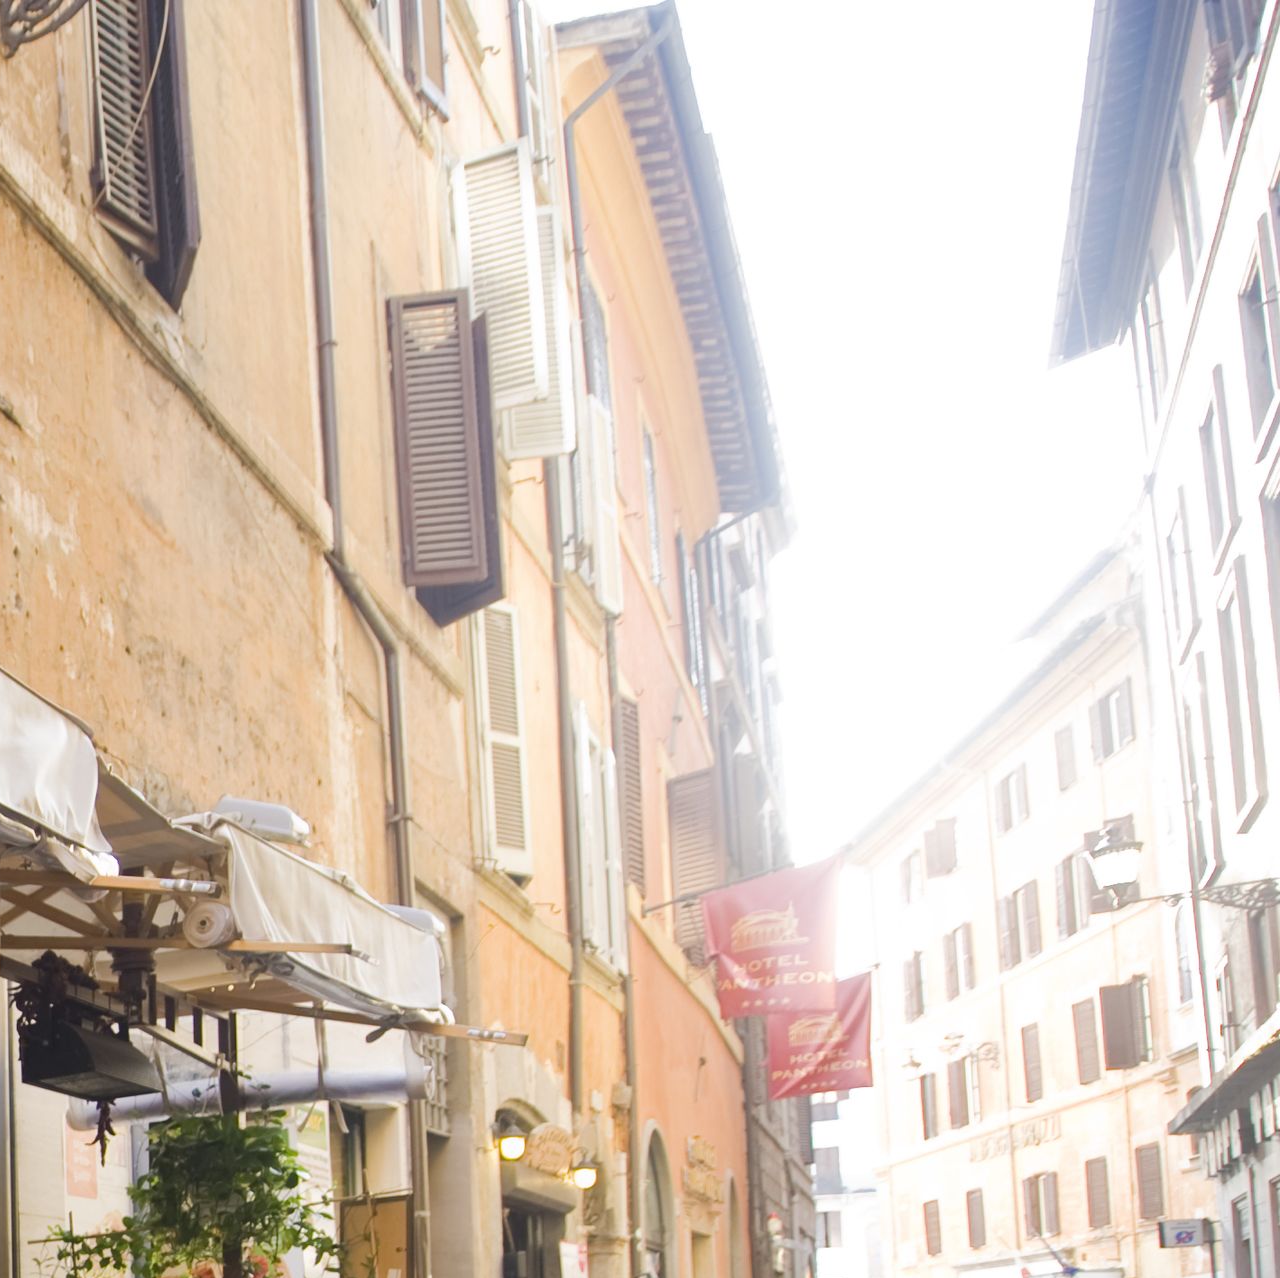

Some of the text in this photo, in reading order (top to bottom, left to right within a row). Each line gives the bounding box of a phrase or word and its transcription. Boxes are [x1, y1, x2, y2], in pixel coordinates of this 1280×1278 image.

[731, 953, 809, 975] HOTEL
[790, 1048, 850, 1064] HOTEL
[771, 1059, 868, 1081] PANTHEON
